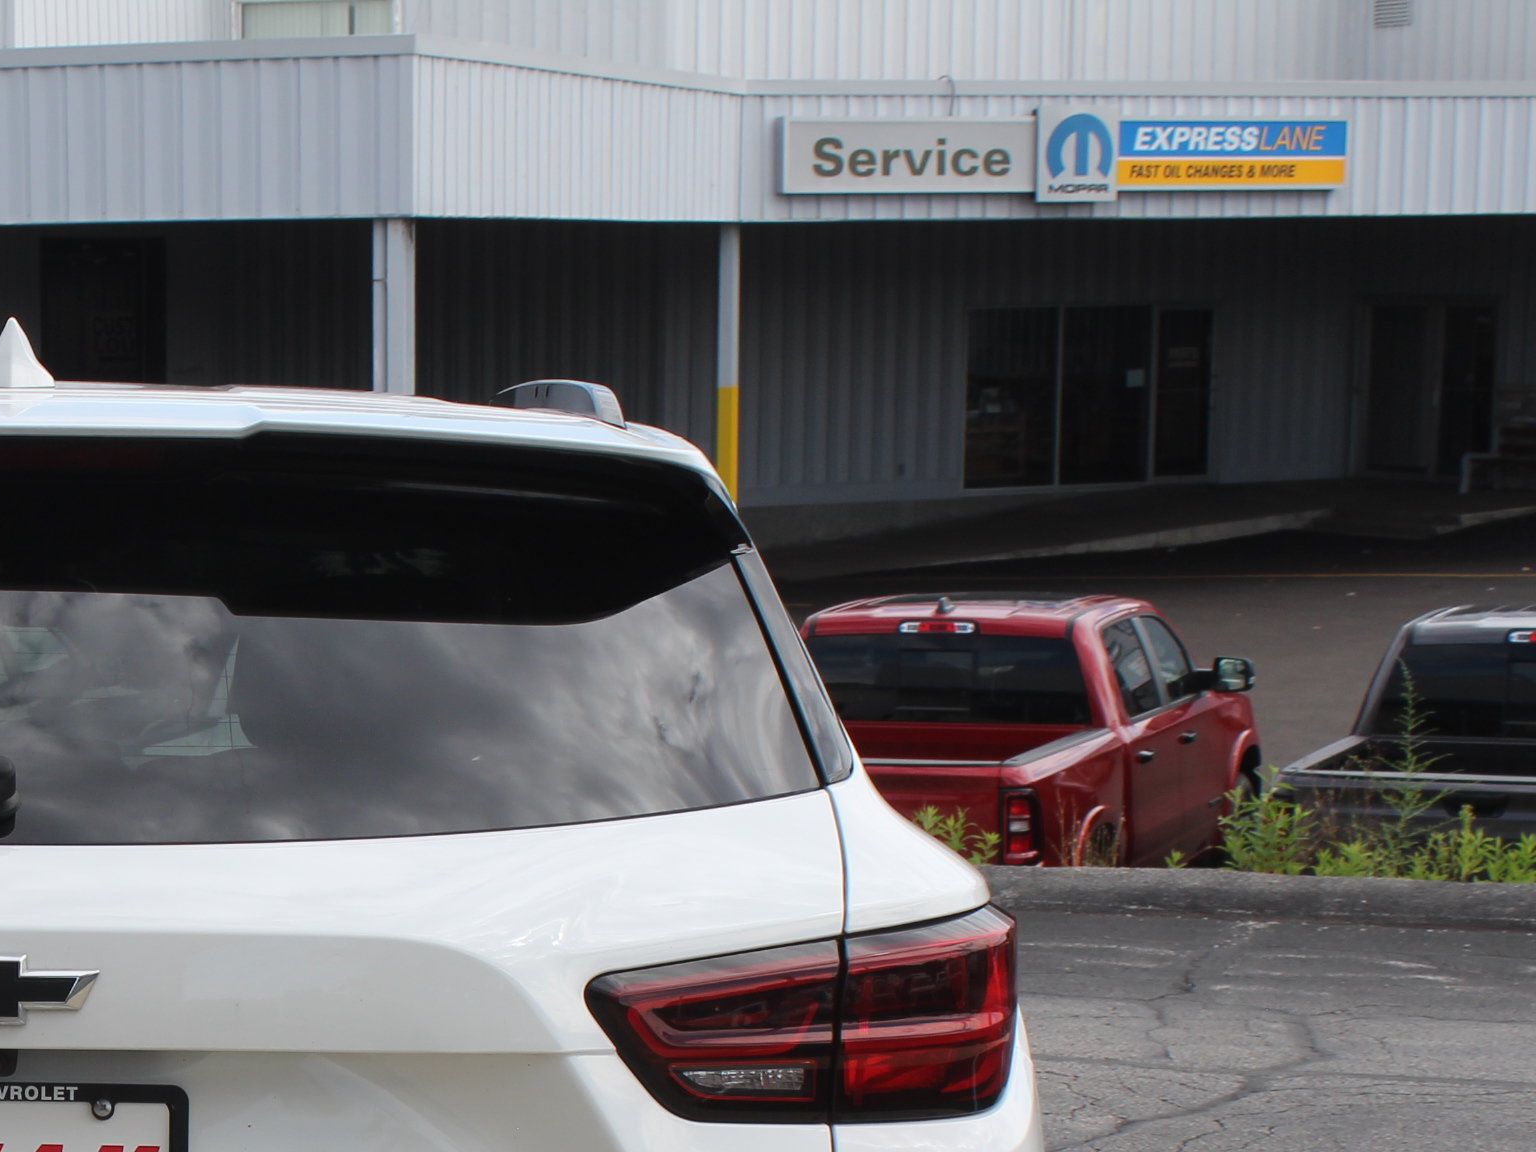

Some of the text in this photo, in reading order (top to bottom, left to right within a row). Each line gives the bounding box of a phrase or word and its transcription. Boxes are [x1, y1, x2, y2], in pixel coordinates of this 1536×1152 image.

[812, 136, 1012, 177] Service
[1130, 164, 1296, 178] FAST OIL CHANGES & MORE
[1047, 183, 1110, 194] MOPAR
